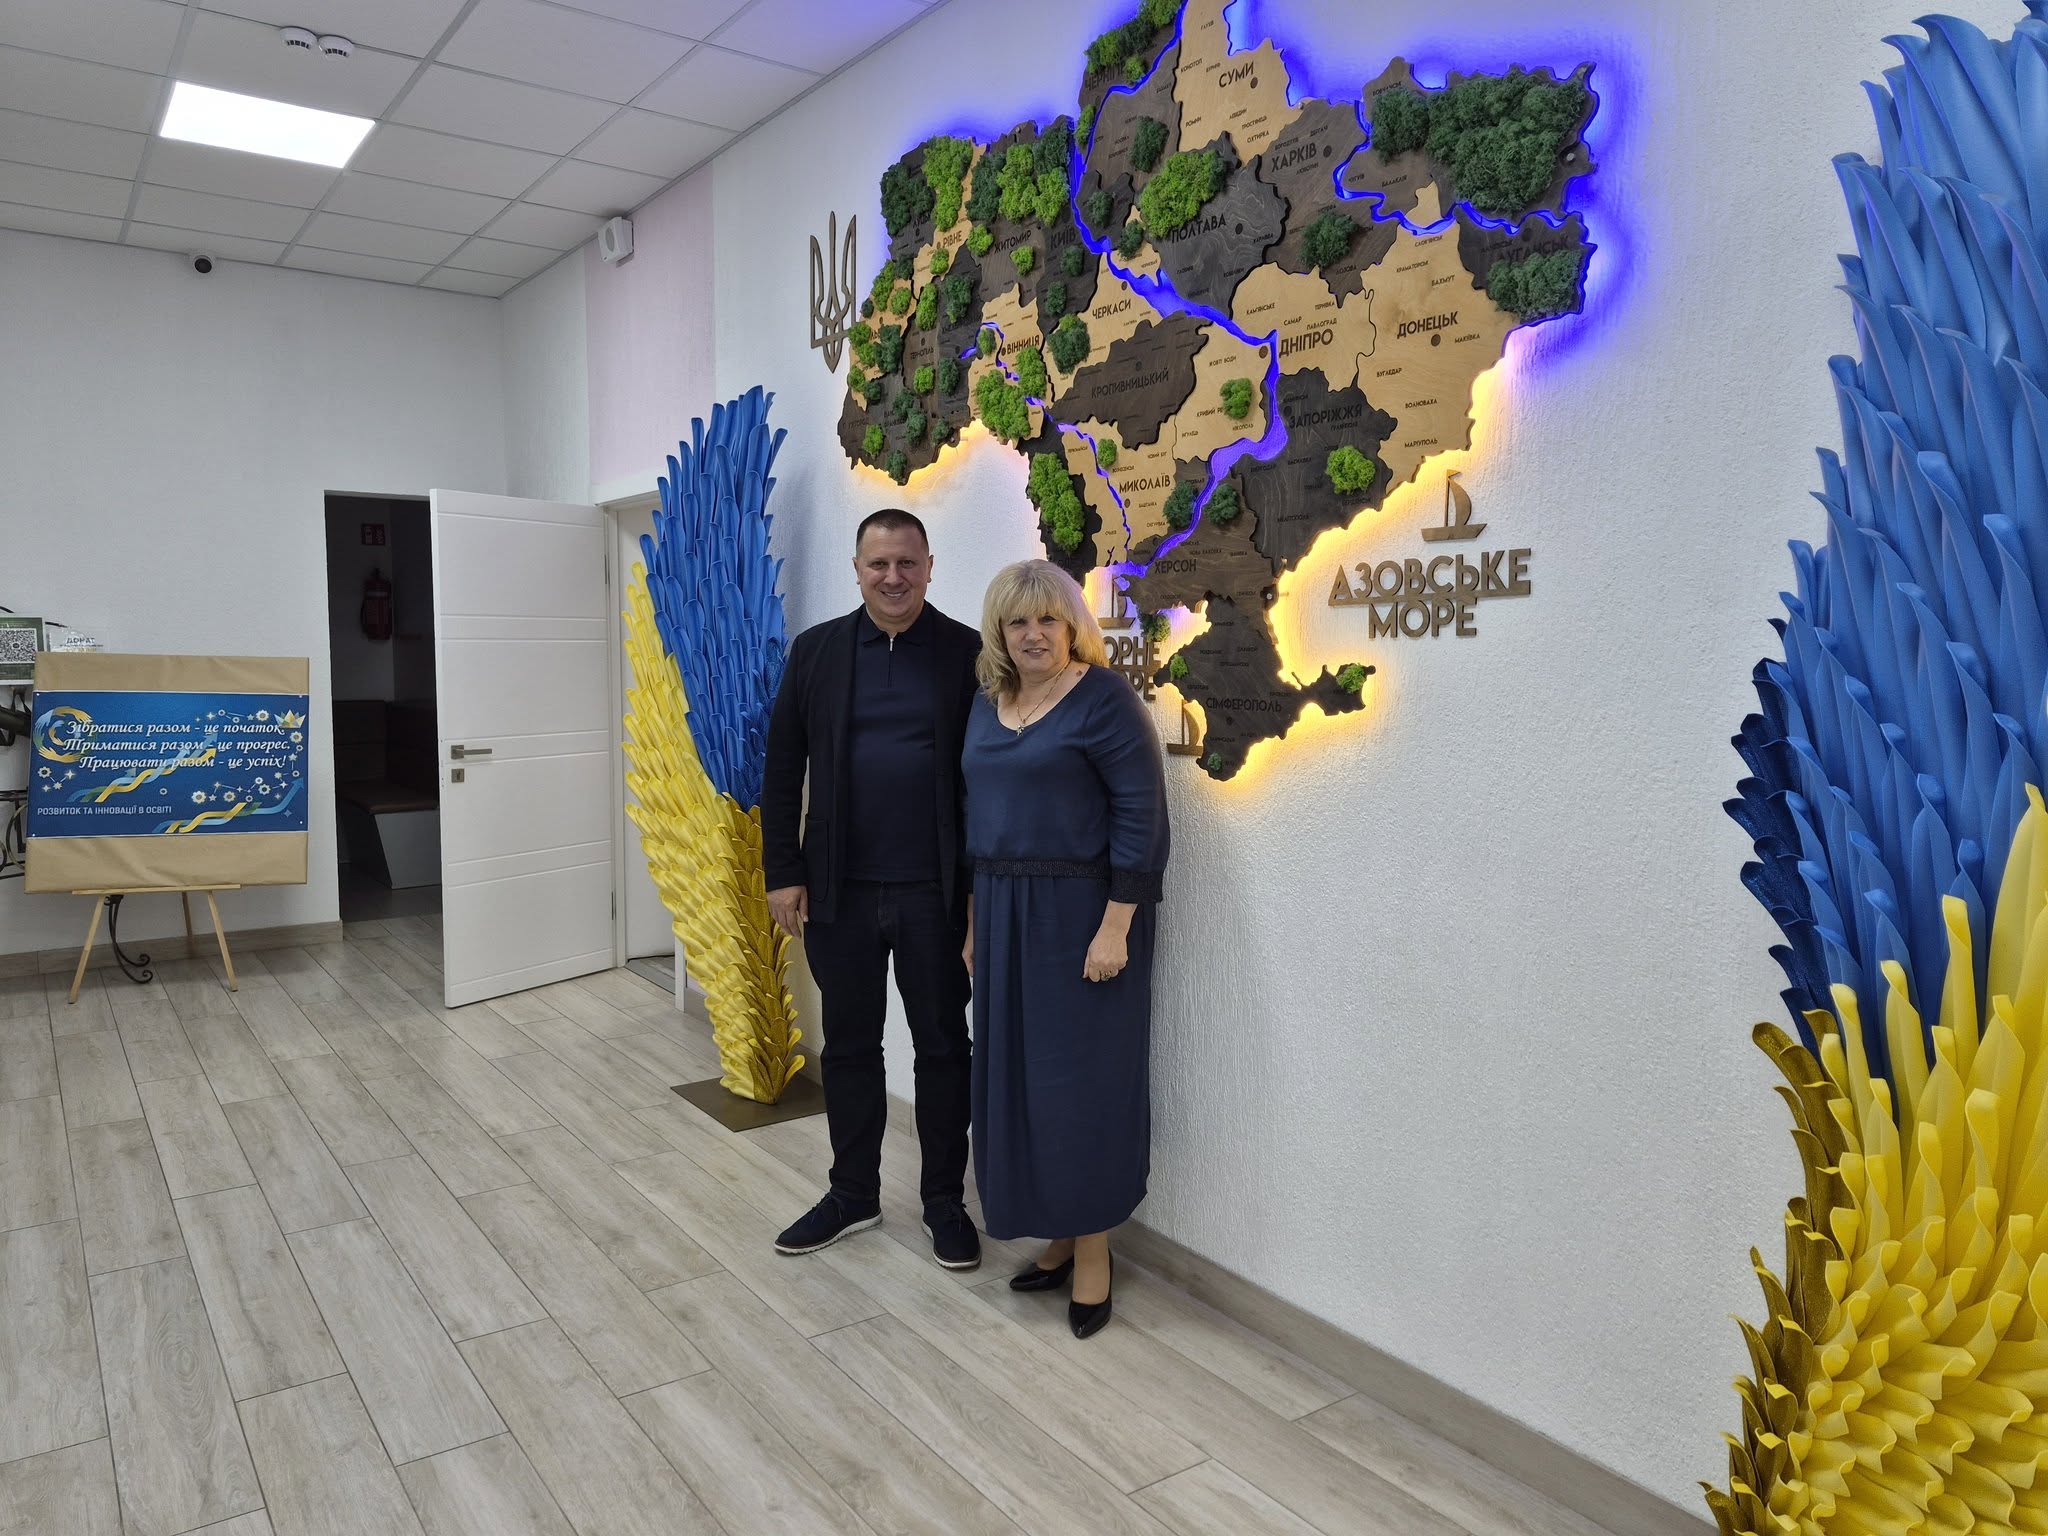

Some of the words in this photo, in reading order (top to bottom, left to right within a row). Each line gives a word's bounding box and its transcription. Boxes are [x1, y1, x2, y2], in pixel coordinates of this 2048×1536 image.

[1181, 58, 1203, 73] КОНОТОП
[1218, 61, 1254, 88] СУМИ
[1247, 131, 1270, 143] ОХТИРКА
[1271, 142, 1317, 173] ХАРКІВ
[1171, 213, 1226, 244] ПОЛТАВА
[942, 230, 962, 249] РІВНЕ
[994, 230, 1031, 254] ЖИТОМИР
[1050, 227, 1076, 251] КИЇВ
[1431, 274, 1456, 287] БАХМУТ
[1092, 299, 1132, 320] ЧЕРКАСИ
[1283, 316, 1302, 326] САМАР
[1306, 318, 1338, 331] ПАВЛОГРАД
[1396, 311, 1459, 339] ДОНЕЦЬК
[1006, 334, 1040, 355] ВІННИЦЯ
[1279, 328, 1333, 358] ДНІПРО
[1223, 355, 1236, 365] ВОДИ
[1376, 367, 1402, 378] ВУГЛЕДАР
[1091, 367, 1169, 399] КРОПИВНИЦЬКИЙ
[1405, 398, 1438, 409] ВОЛНОВАХА
[1196, 408, 1215, 418] КРИВИЙ
[1289, 403, 1362, 429] ЗАПОРІЖЖЯ
[1404, 437, 1438, 448] МАРІУПОЛЬ
[1119, 472, 1170, 494] МИКОЛАЇВ
[1154, 558, 1197, 575] ХЕРСОН
[1328, 548, 1531, 606] АЗОВСЬКЕ
[1368, 597, 1477, 639] МОРЕ
[1104, 636, 1162, 668] ОРНЕ
[1205, 697, 1282, 713] СІМФЕРОПОЛЬ
[66, 721, 143, 736] Зібратися
[146, 724, 190, 736] разом
[204, 724, 219, 735] це
[223, 724, 285, 735] початок.
[63, 739, 157, 754] Триматися
[159, 741, 204, 754] разом
[217, 741, 233, 752] це
[237, 741, 290, 754] прогрес.
[79, 756, 168, 772] Працювати
[171, 758, 214, 770] разом
[228, 758, 243, 769] це
[245, 755, 286, 770] успіх!
[37, 806, 81, 815] РОЗВИТОК
[83, 806, 93, 815] ТА
[95, 804, 136, 815] ІННОВАЦІЇ
[138, 806, 144, 814] В
[146, 805, 172, 814] ОСВІТІ
